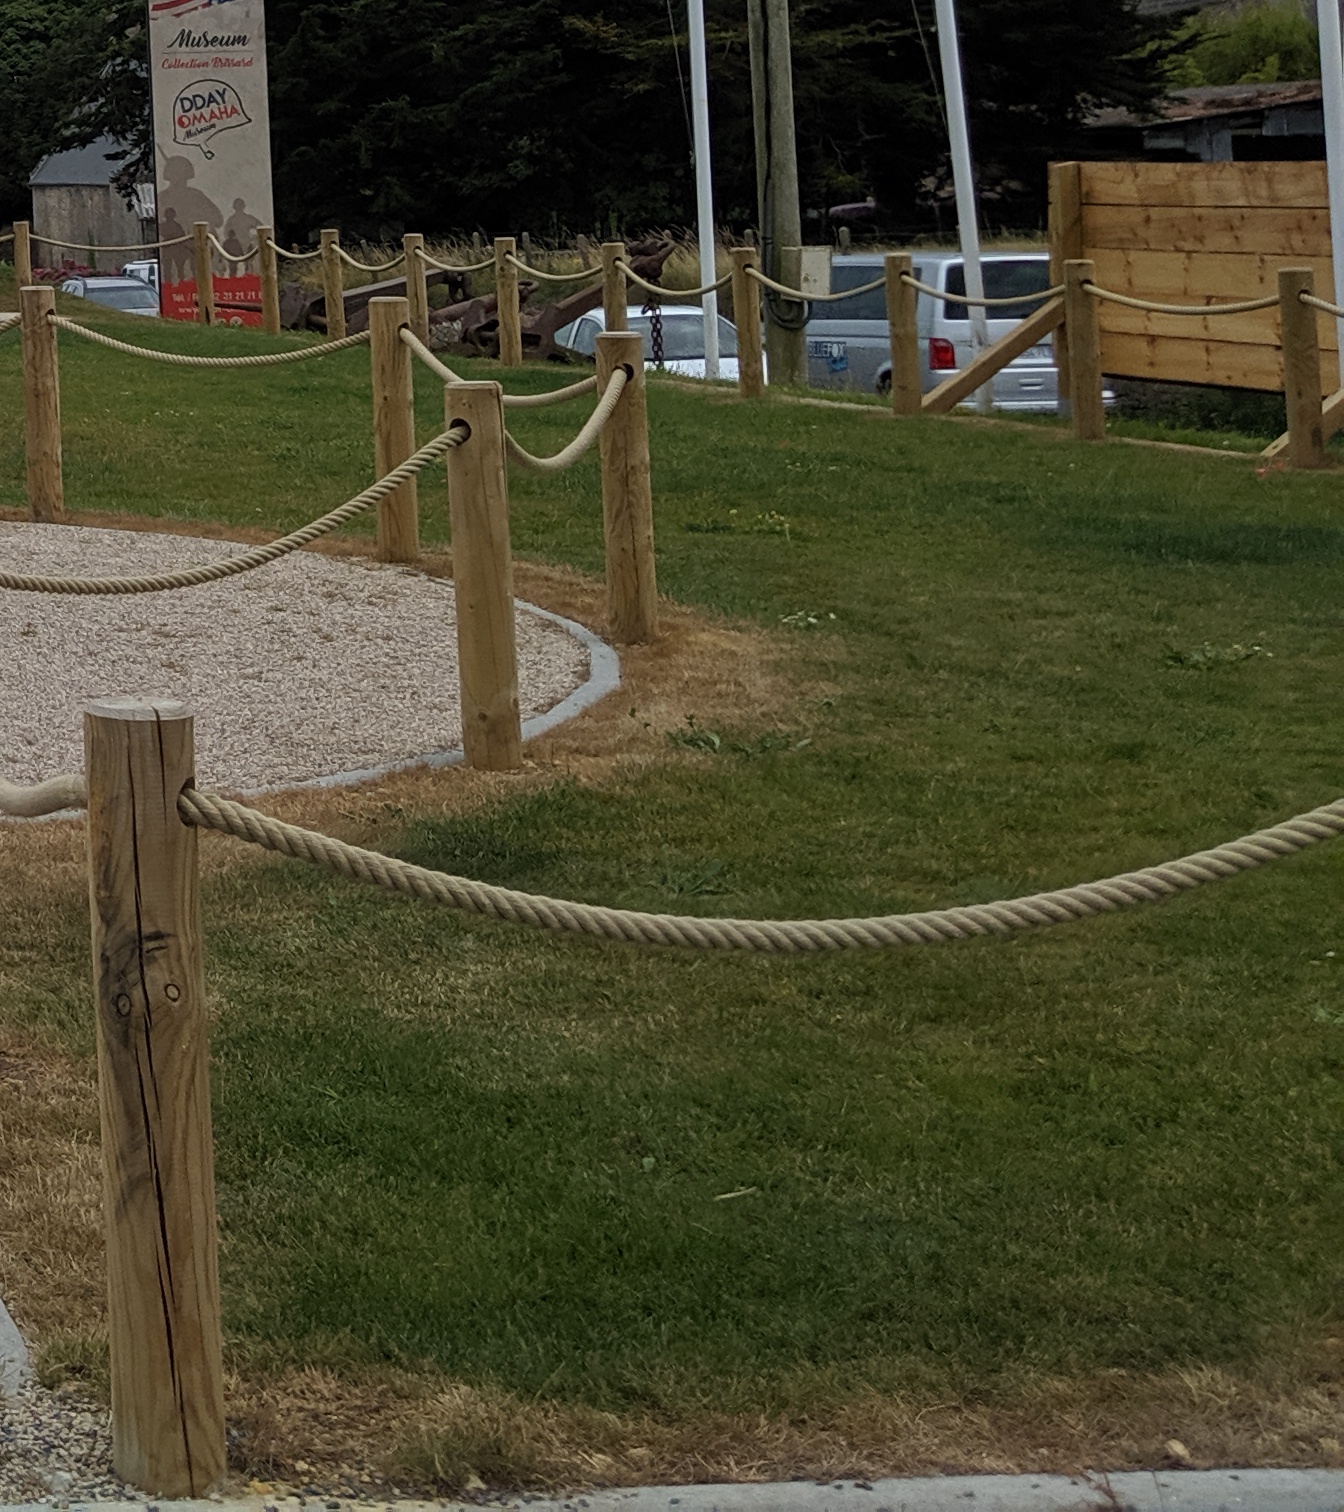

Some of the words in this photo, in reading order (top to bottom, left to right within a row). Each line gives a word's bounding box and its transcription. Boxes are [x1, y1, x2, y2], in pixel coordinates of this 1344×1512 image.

[167, 28, 250, 48] Museum
[161, 58, 209, 69] Collection
[179, 87, 227, 113] DDAY
[177, 105, 241, 128] OMAHA
